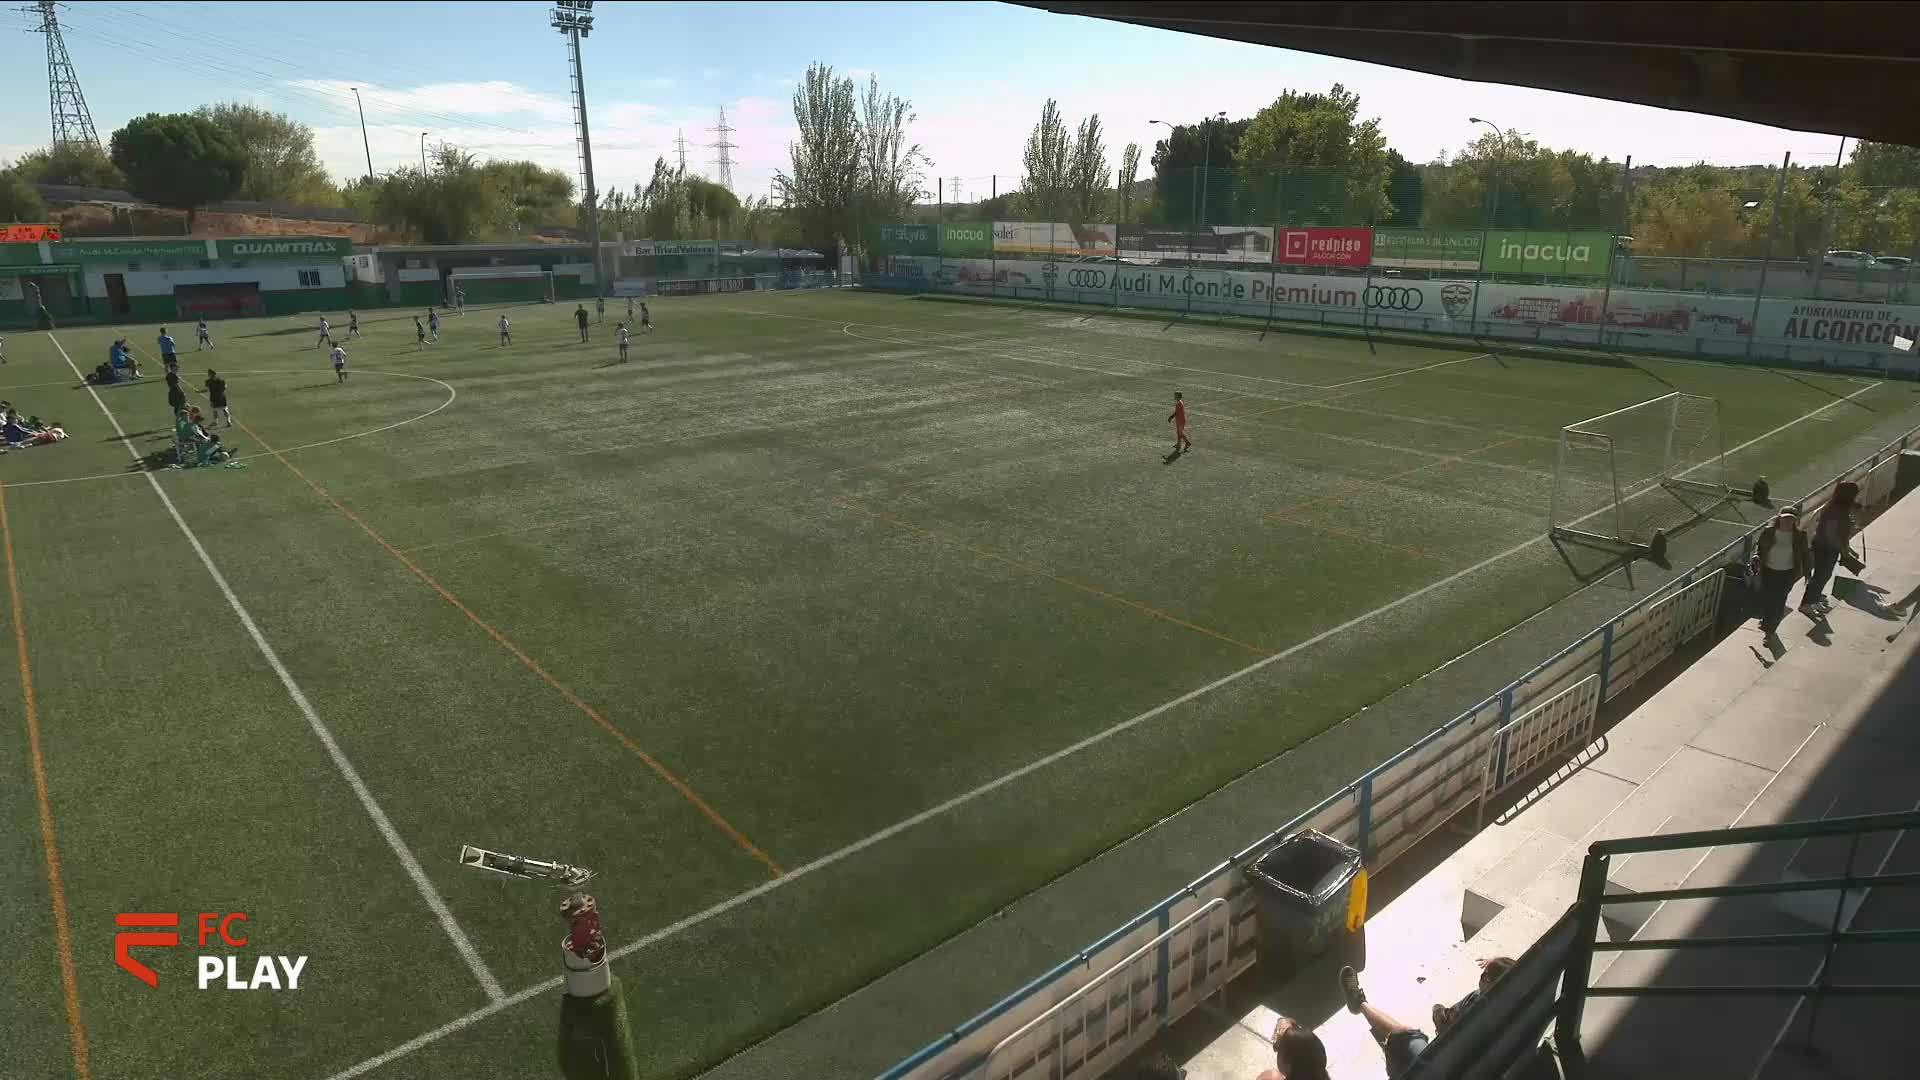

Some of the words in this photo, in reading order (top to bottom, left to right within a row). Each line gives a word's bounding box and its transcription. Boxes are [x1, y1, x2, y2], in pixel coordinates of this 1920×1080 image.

[947, 228, 984, 241] inacua
[233, 241, 336, 254] QUAMTRAX
[1312, 236, 1361, 252] redpiso
[1499, 238, 1591, 262] inacua
[1110, 272, 1151, 292] Audi
[1252, 278, 1357, 307] Premium
[1792, 305, 1874, 320] AYUNTAMIENTO
[1877, 310, 1892, 321] DE
